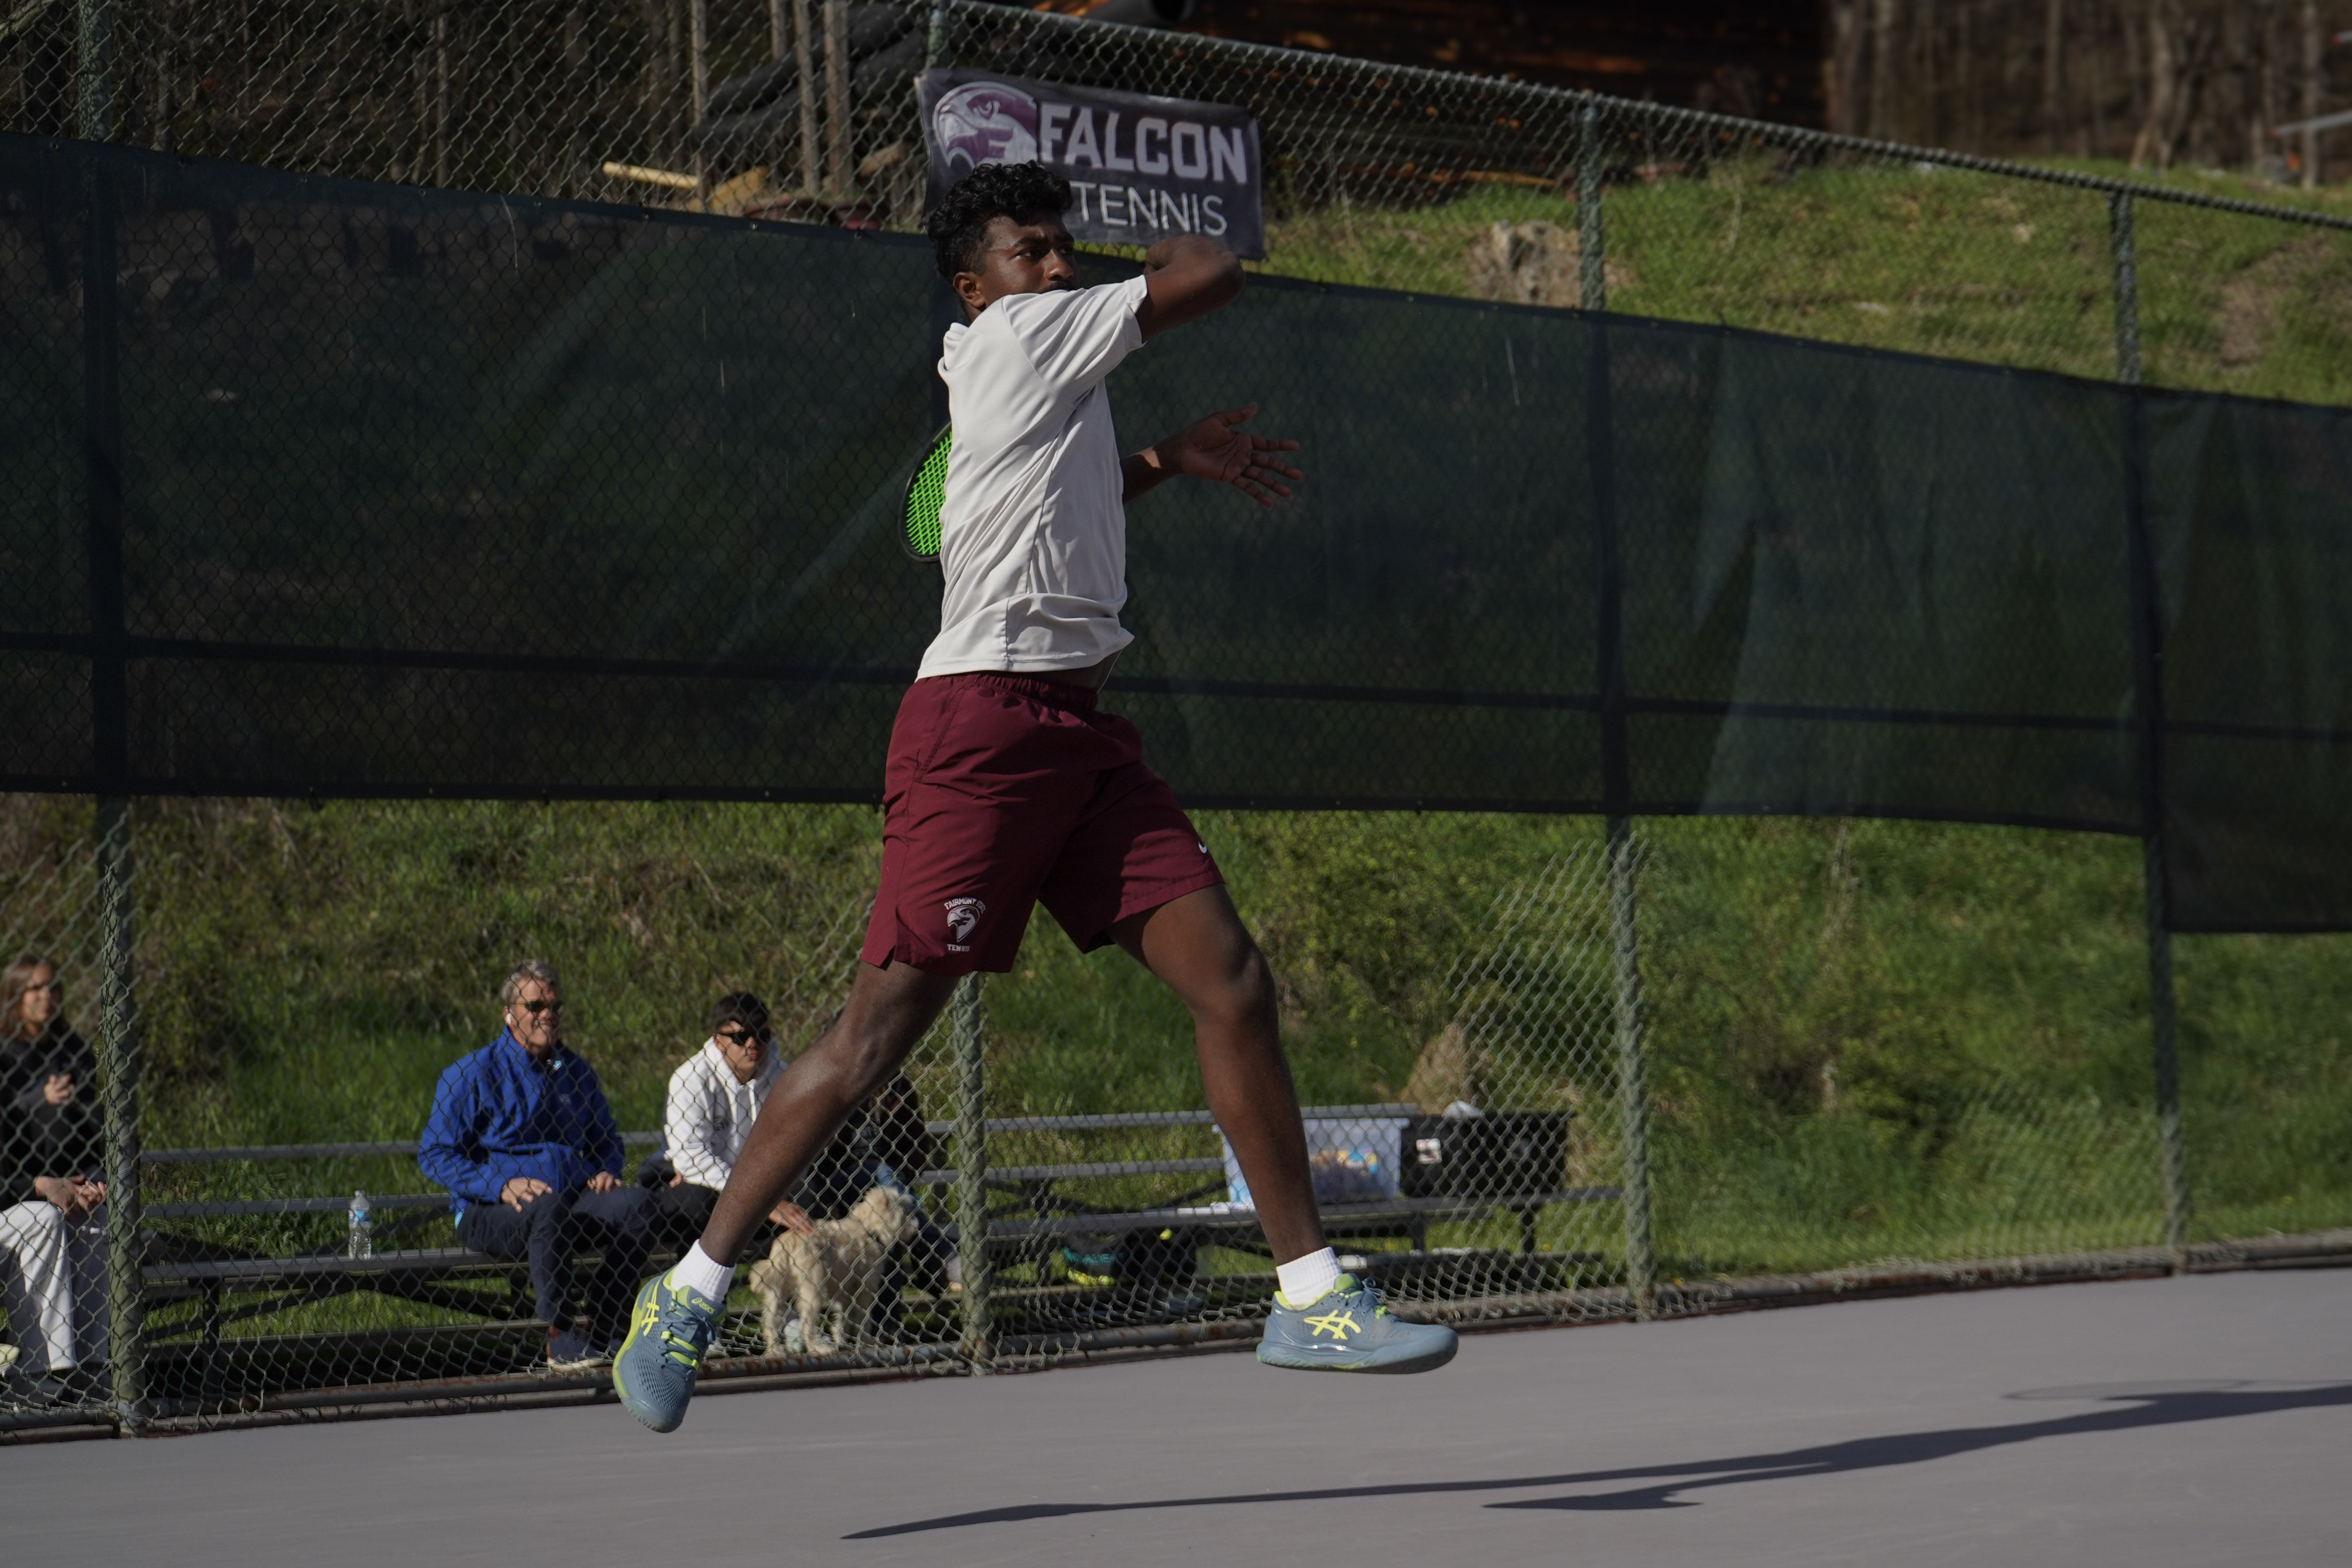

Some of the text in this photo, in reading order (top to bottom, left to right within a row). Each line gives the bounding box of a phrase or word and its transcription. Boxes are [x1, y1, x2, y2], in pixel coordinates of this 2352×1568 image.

[1039, 102, 1248, 184] FALCON
[1071, 181, 1228, 236] TENNIS
[944, 897, 977, 909] FAIRMONT
[947, 944, 971, 952] TENNIS
